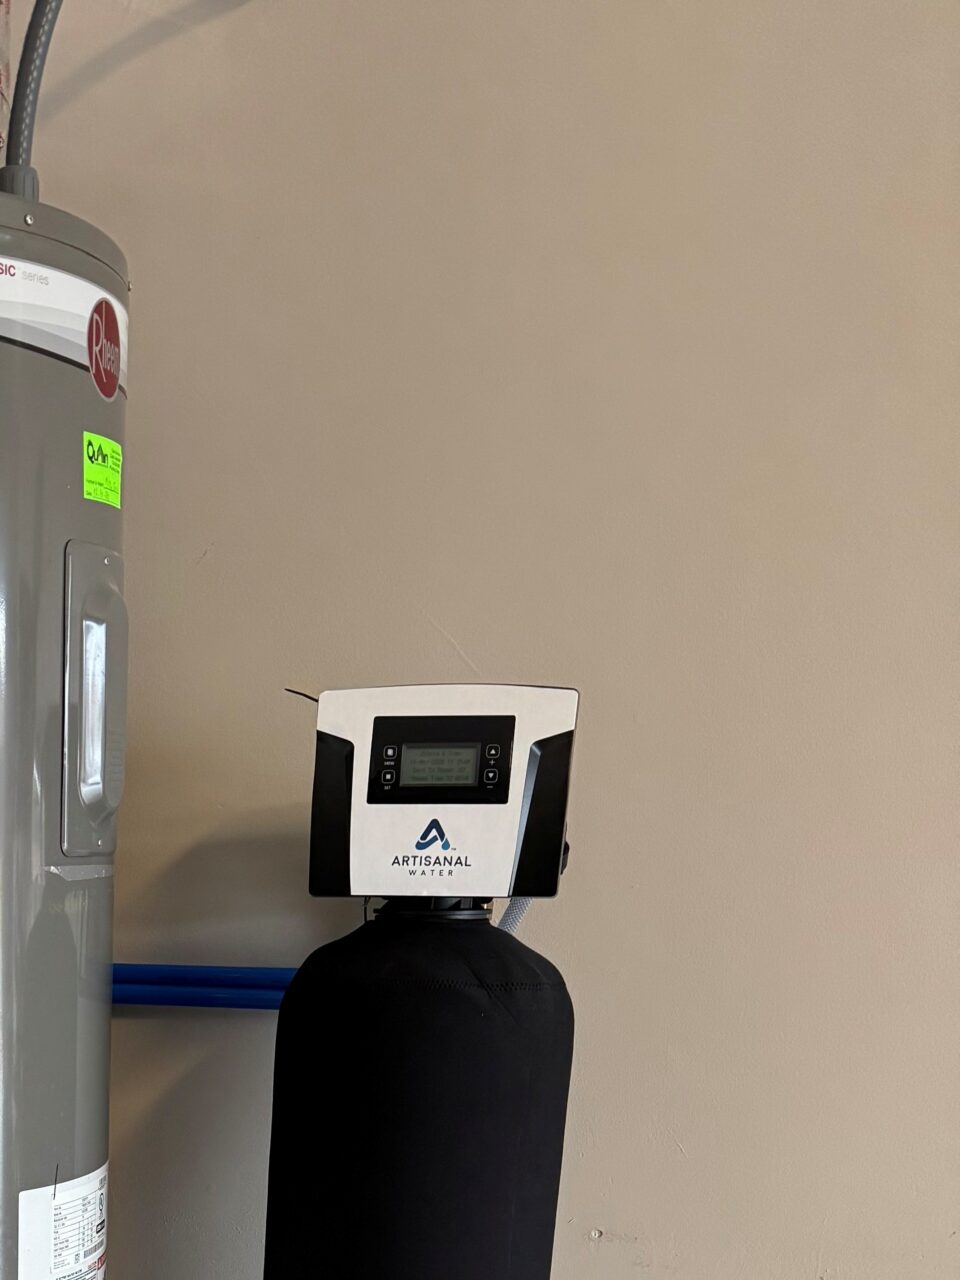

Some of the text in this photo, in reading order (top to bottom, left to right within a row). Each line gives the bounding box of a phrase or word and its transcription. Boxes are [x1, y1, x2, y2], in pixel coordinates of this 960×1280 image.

[21, 270, 50, 286] series
[92, 301, 120, 383] Rheem
[391, 855, 472, 867] ARTISANAL
[408, 869, 454, 877] WATER
